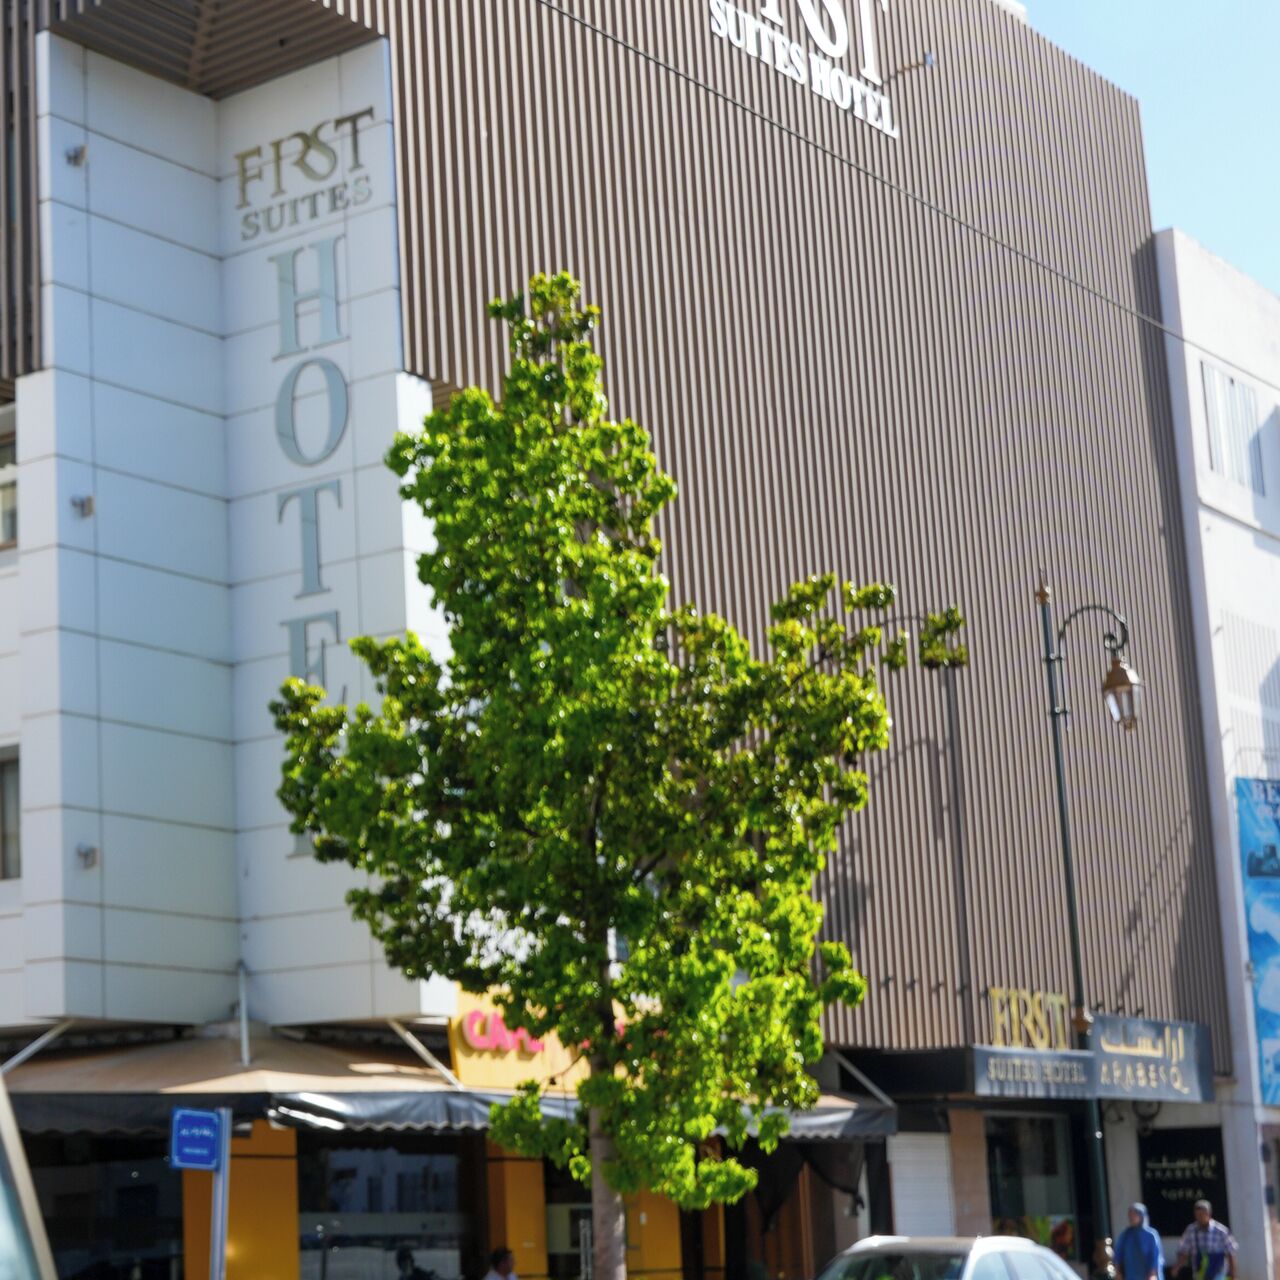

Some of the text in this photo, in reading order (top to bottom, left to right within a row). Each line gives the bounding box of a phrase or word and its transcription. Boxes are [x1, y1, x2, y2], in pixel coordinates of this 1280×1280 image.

[809, 52, 899, 140] HOTEL
[234, 106, 375, 209] FIRST
[240, 175, 374, 241] SUITES
[267, 233, 351, 710] HOTE
[989, 987, 1070, 1050] FIRST
[987, 1057, 1087, 1084] SUITES HOTEL
[1100, 1060, 1190, 1095] ARABESQ
